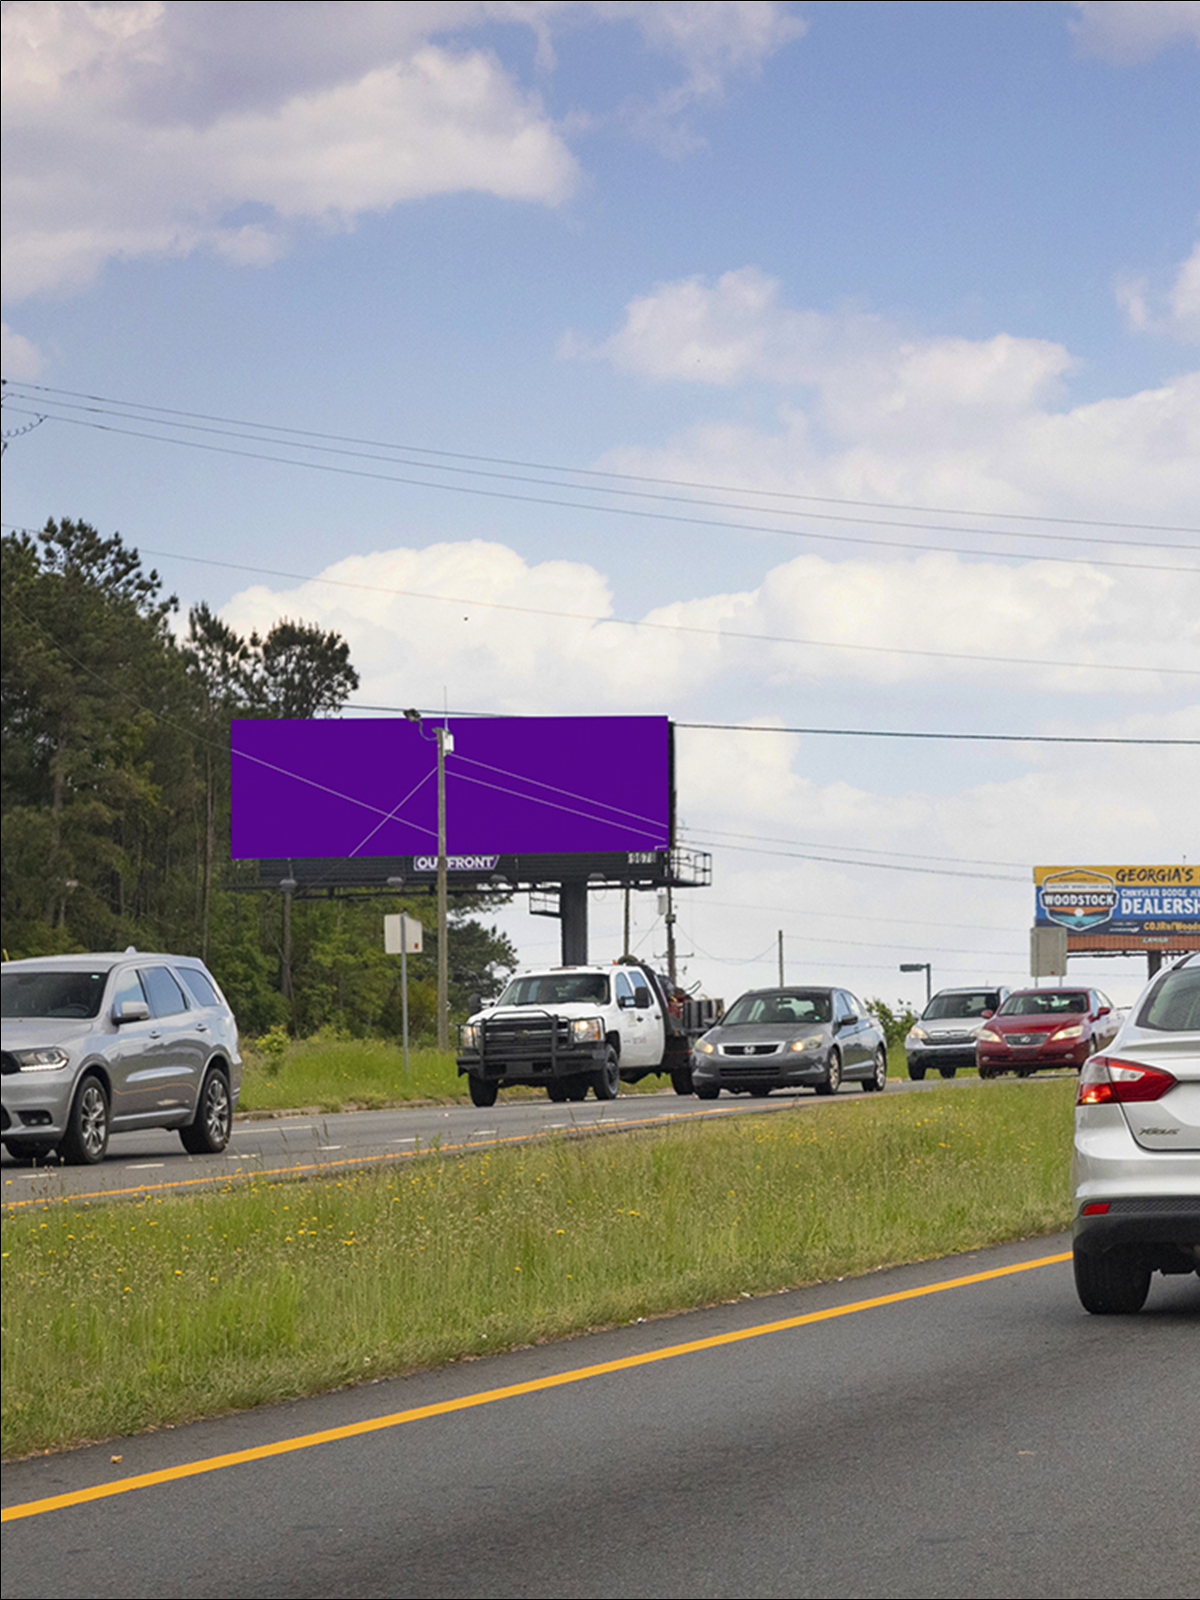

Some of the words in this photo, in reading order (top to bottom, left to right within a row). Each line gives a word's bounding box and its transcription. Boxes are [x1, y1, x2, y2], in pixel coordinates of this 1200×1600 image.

[417, 856, 494, 869] OUFRONT
[1116, 868, 1194, 883] GEORGIA'S
[1121, 888, 1160, 897] CHRYSLER
[1162, 888, 1187, 897] DODGE
[1044, 894, 1114, 905] WOODSTOCK
